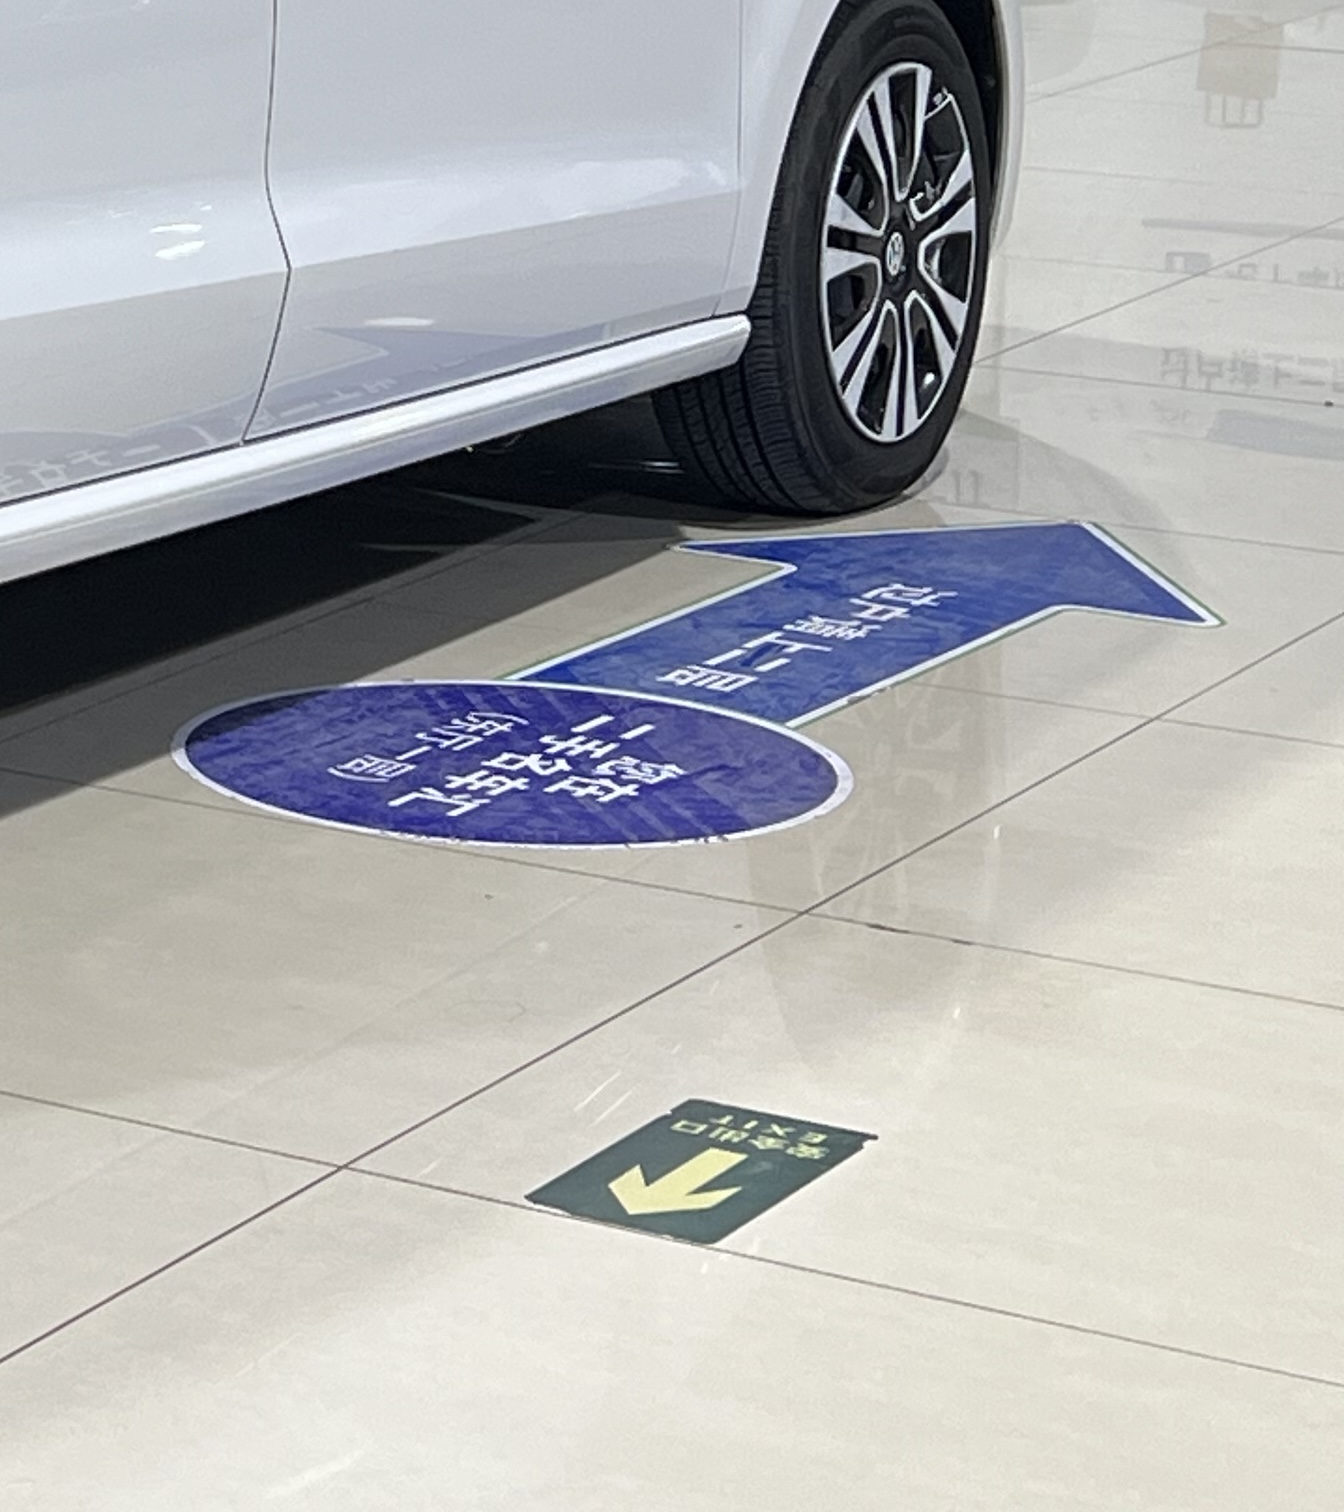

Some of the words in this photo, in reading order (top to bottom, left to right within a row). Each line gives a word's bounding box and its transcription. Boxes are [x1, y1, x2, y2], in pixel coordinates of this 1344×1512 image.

[655, 582, 959, 693] 过户请上二层
[387, 714, 656, 817] 二手名车汇
[543, 755, 688, 802] 您在
[670, 1119, 830, 1159] 安全出口
[709, 1114, 828, 1145] EXIT
